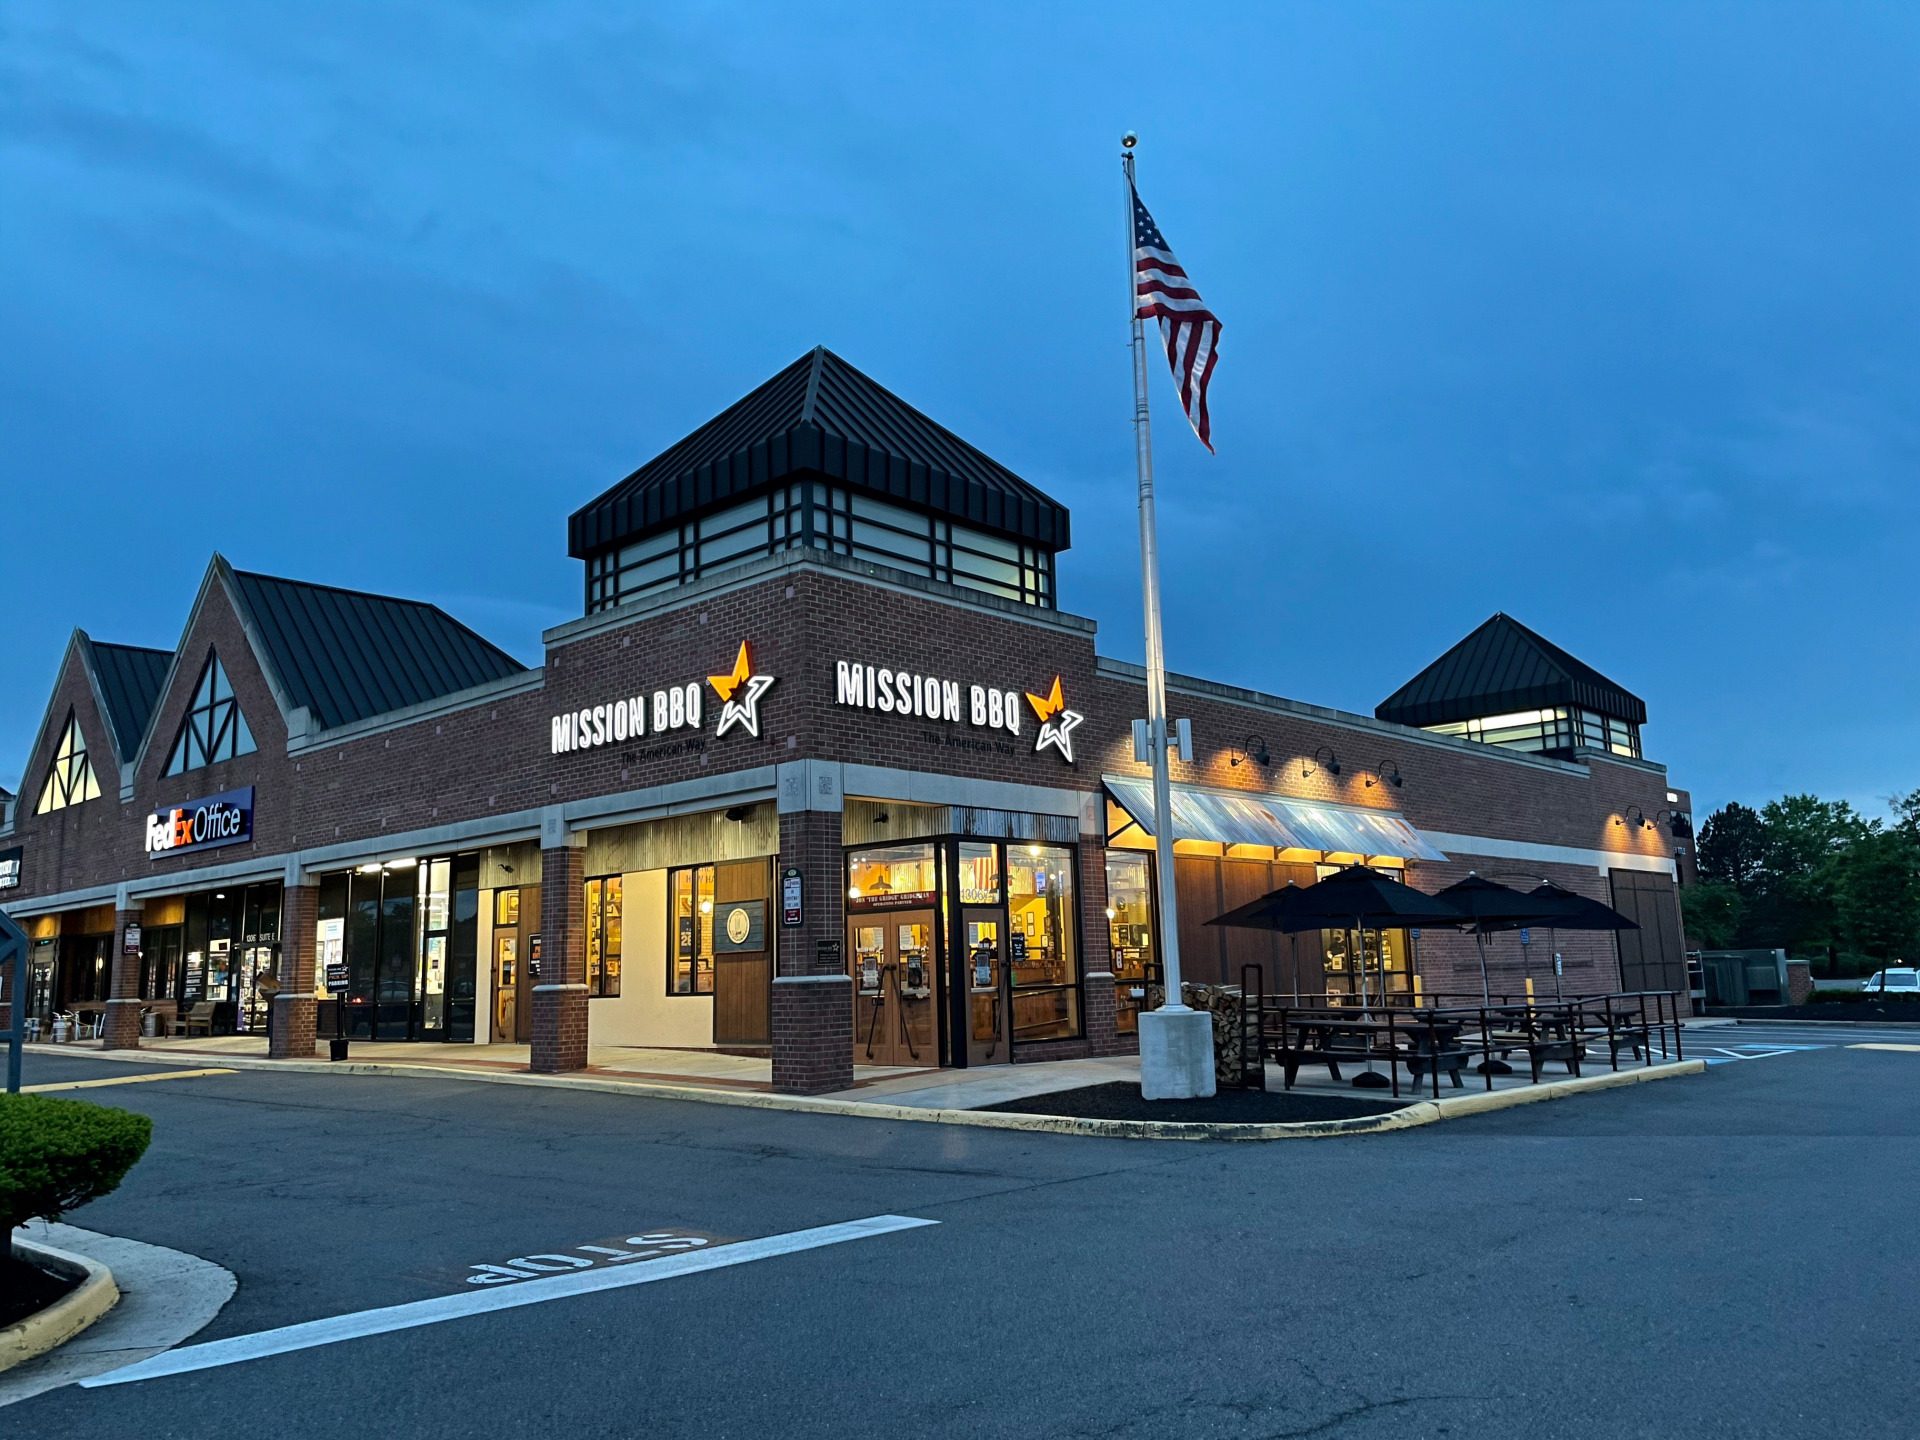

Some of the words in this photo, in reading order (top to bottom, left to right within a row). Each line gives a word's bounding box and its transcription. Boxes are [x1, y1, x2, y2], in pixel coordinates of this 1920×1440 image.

[551, 696, 644, 754] MISSION
[653, 682, 701, 733] BBQ
[837, 660, 960, 722] MISSION
[970, 685, 1020, 736] BBQ
[621, 752, 637, 764] The
[639, 743, 683, 761] American
[685, 738, 706, 754] Way
[921, 730, 940, 744] The
[944, 735, 991, 752] American
[995, 741, 1015, 757] Way
[145, 808, 194, 852] FedEx
[194, 802, 240, 842] Office
[465, 1233, 708, 1284] STOP
